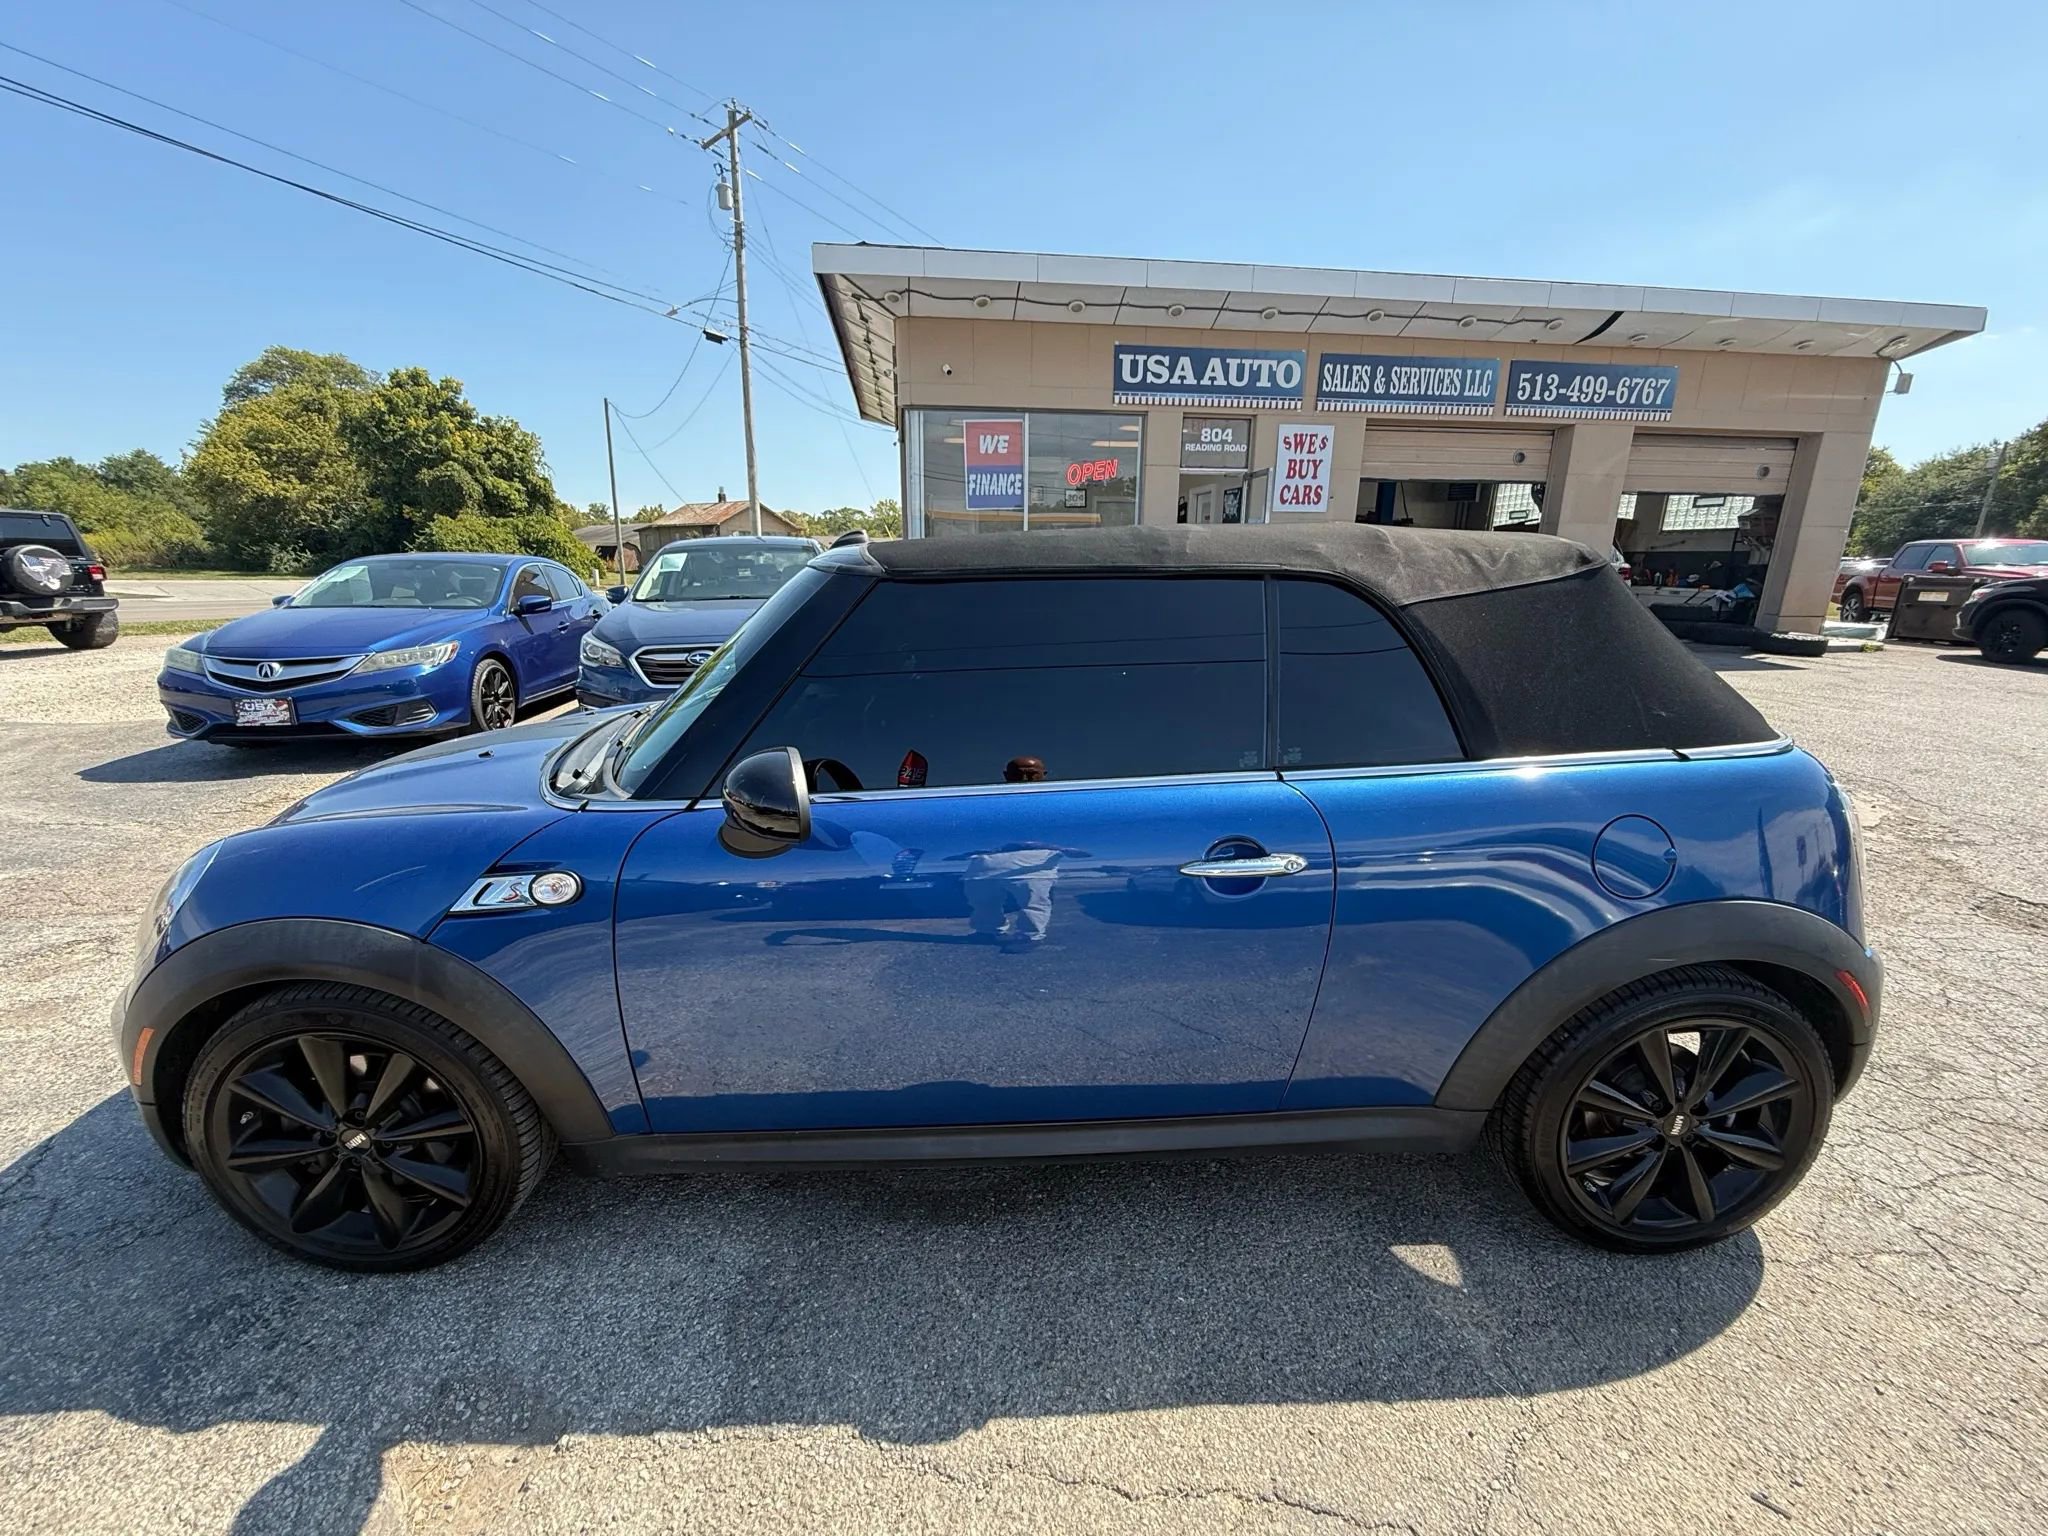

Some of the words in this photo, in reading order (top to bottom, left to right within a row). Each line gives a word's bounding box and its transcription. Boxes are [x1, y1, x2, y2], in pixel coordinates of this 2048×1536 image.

[1119, 354, 1197, 385] USA
[1200, 357, 1302, 389] AUTO
[1322, 362, 1371, 394] SALES
[1373, 365, 1386, 395] &
[1389, 366, 1462, 397] SERVICES
[1464, 369, 1493, 397] LLC
[1517, 373, 1671, 405] 513-499-6767
[979, 434, 1010, 454] WE
[1200, 428, 1233, 443] 804
[1185, 443, 1222, 452] READING
[1223, 444, 1247, 453] ROAD
[1067, 459, 1118, 485] OPEN
[1285, 458, 1323, 480] BUY
[968, 473, 1023, 497] FINANCE
[1279, 484, 1324, 506] CARS
